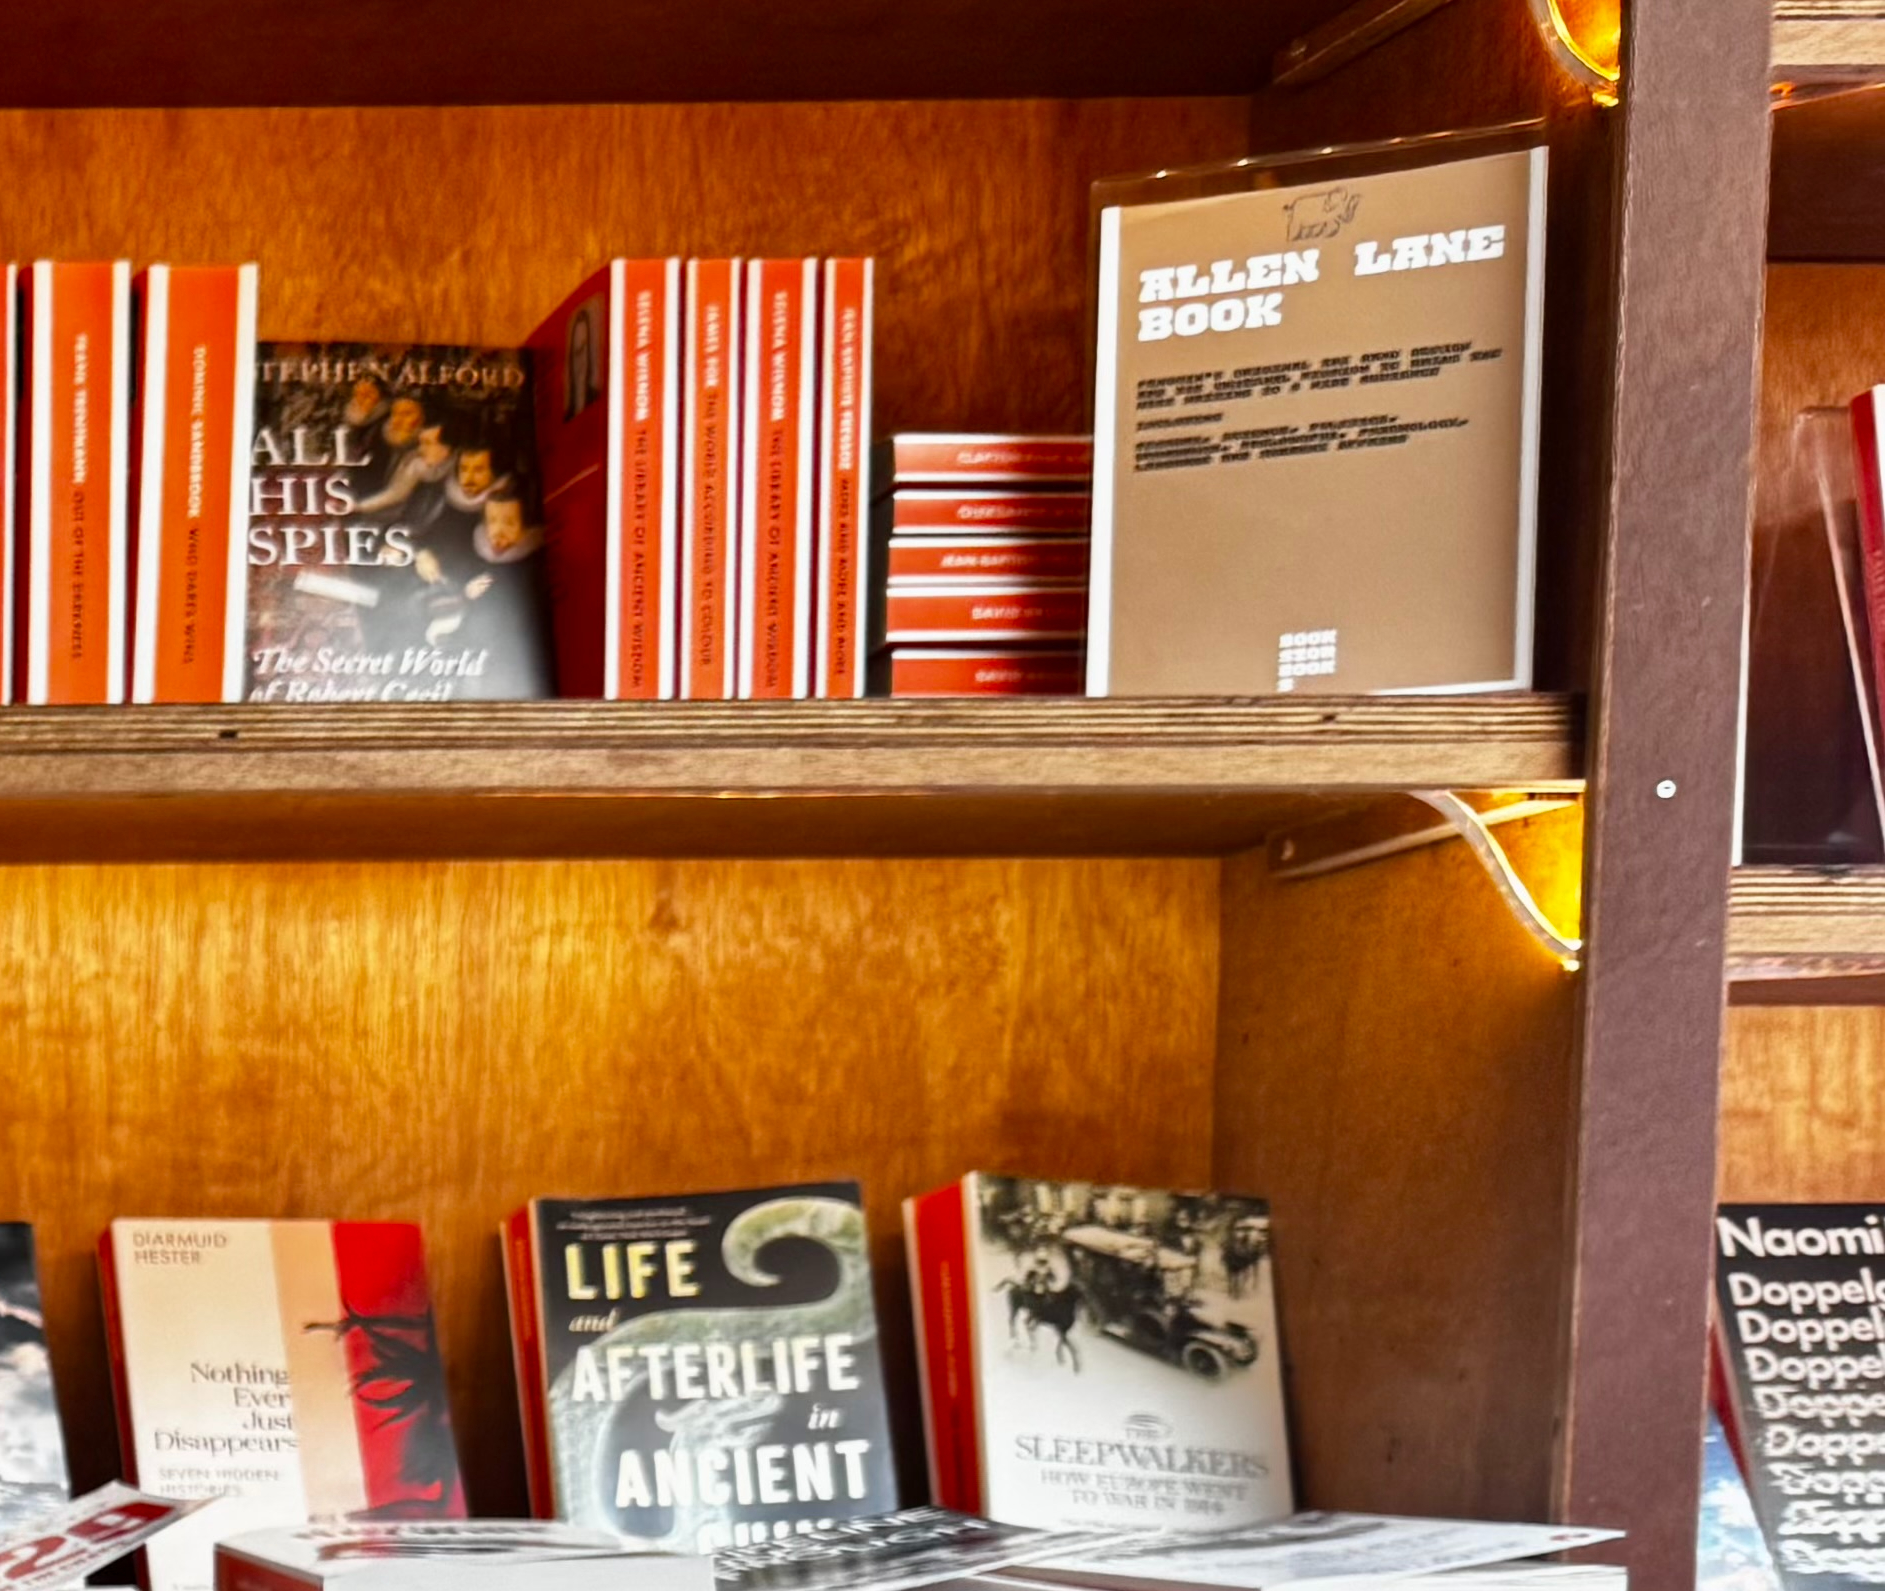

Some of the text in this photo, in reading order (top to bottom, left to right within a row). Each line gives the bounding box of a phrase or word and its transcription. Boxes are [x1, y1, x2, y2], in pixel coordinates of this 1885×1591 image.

[1138, 224, 1506, 303] ALLEN LANE
[1137, 291, 1284, 342] BOOK
[253, 360, 526, 388] TEPHEN ALFORD
[251, 426, 373, 467] ALL
[249, 475, 356, 516] HIS
[248, 526, 416, 567] SPIES
[252, 646, 489, 677] The Secret World
[132, 1232, 228, 1249] DIARMUID
[1716, 1214, 1885, 1258] Naomi
[133, 1249, 202, 1265] HESTER
[565, 1239, 702, 1300] LIFE
[568, 1307, 619, 1333] and
[190, 1361, 290, 1387] Nothing
[571, 1331, 861, 1402] AFTERLIFE
[1743, 1342, 1885, 1390] Doppe
[232, 1387, 292, 1409] Ever
[807, 1402, 843, 1431] in
[242, 1411, 294, 1432] Just
[154, 1430, 300, 1458] Disappears
[1014, 1433, 1269, 1480] SLEEPWALKERS
[615, 1438, 871, 1509] ANCIENT
